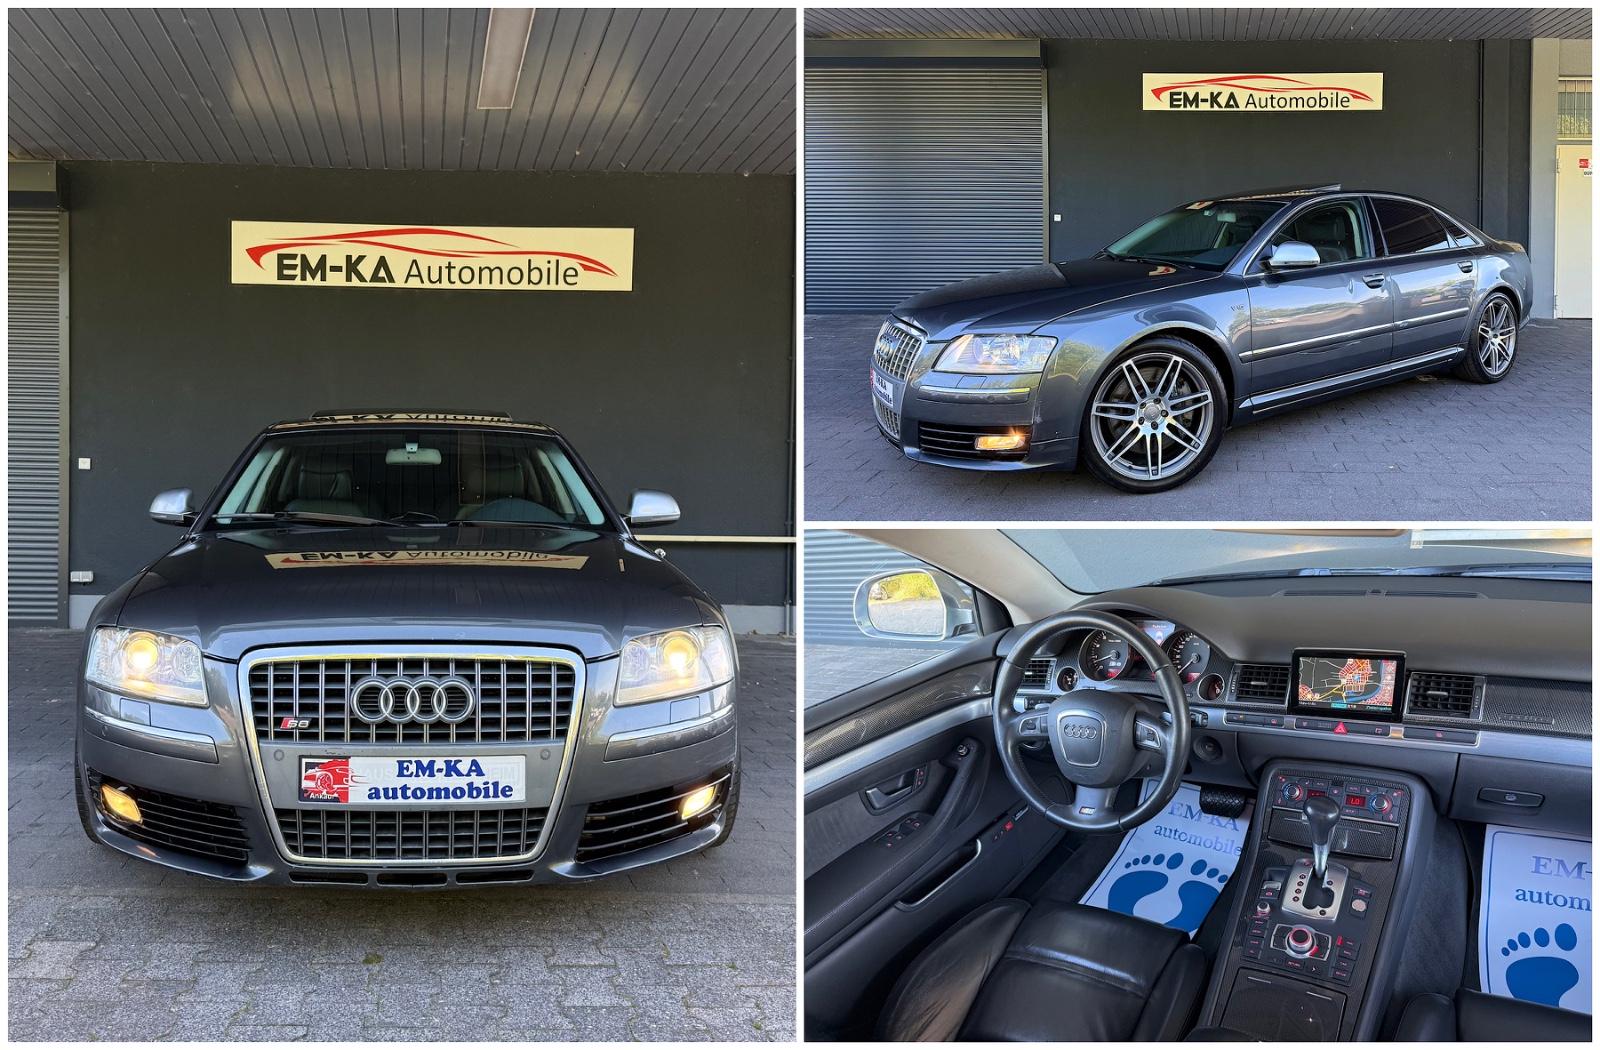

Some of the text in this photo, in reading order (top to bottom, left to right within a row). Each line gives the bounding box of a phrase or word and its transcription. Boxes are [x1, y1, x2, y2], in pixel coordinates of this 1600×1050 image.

[1169, 91, 1351, 109] EM-KA Automobile
[277, 253, 579, 286] EM-KA Automobile
[396, 758, 485, 778] EM-KA
[367, 780, 514, 800] automobile
[1154, 824, 1242, 857] automobile
